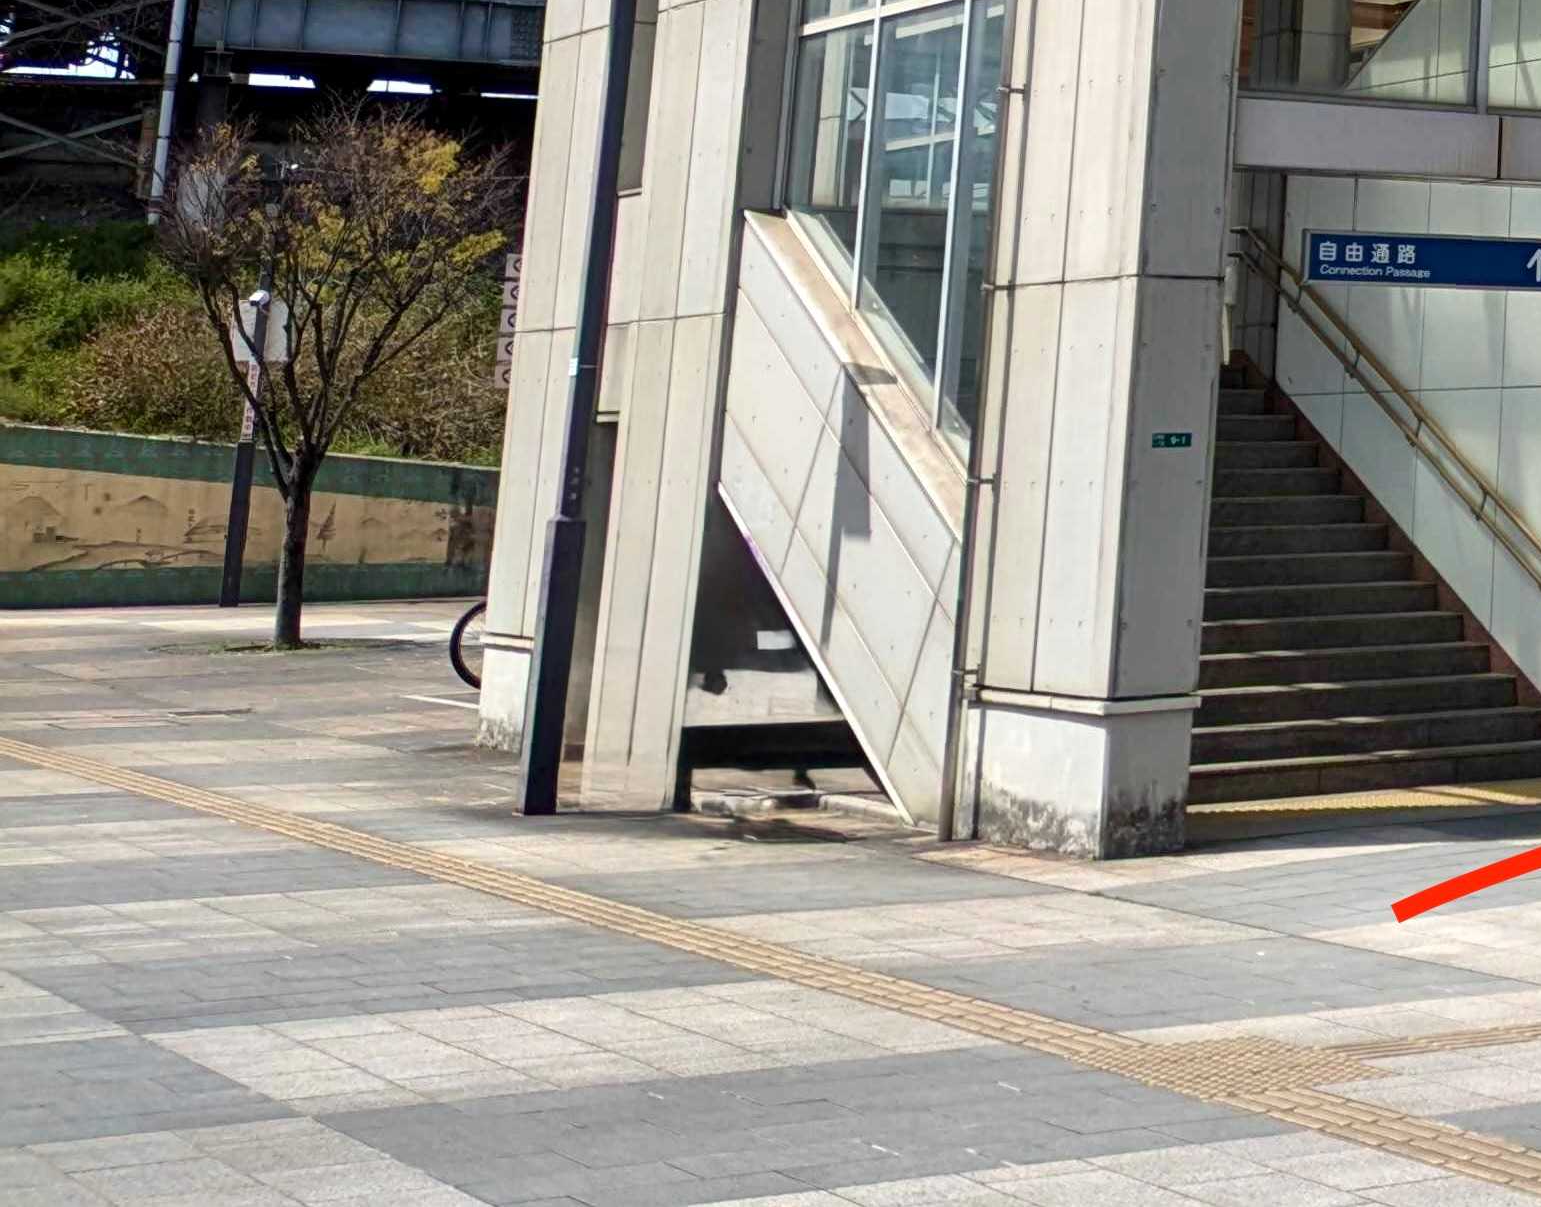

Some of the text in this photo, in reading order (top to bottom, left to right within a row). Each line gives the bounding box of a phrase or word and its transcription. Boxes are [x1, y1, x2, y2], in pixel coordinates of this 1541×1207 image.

[1319, 240, 1416, 265] 自由通路
[1320, 263, 1431, 279] Connection Passage
